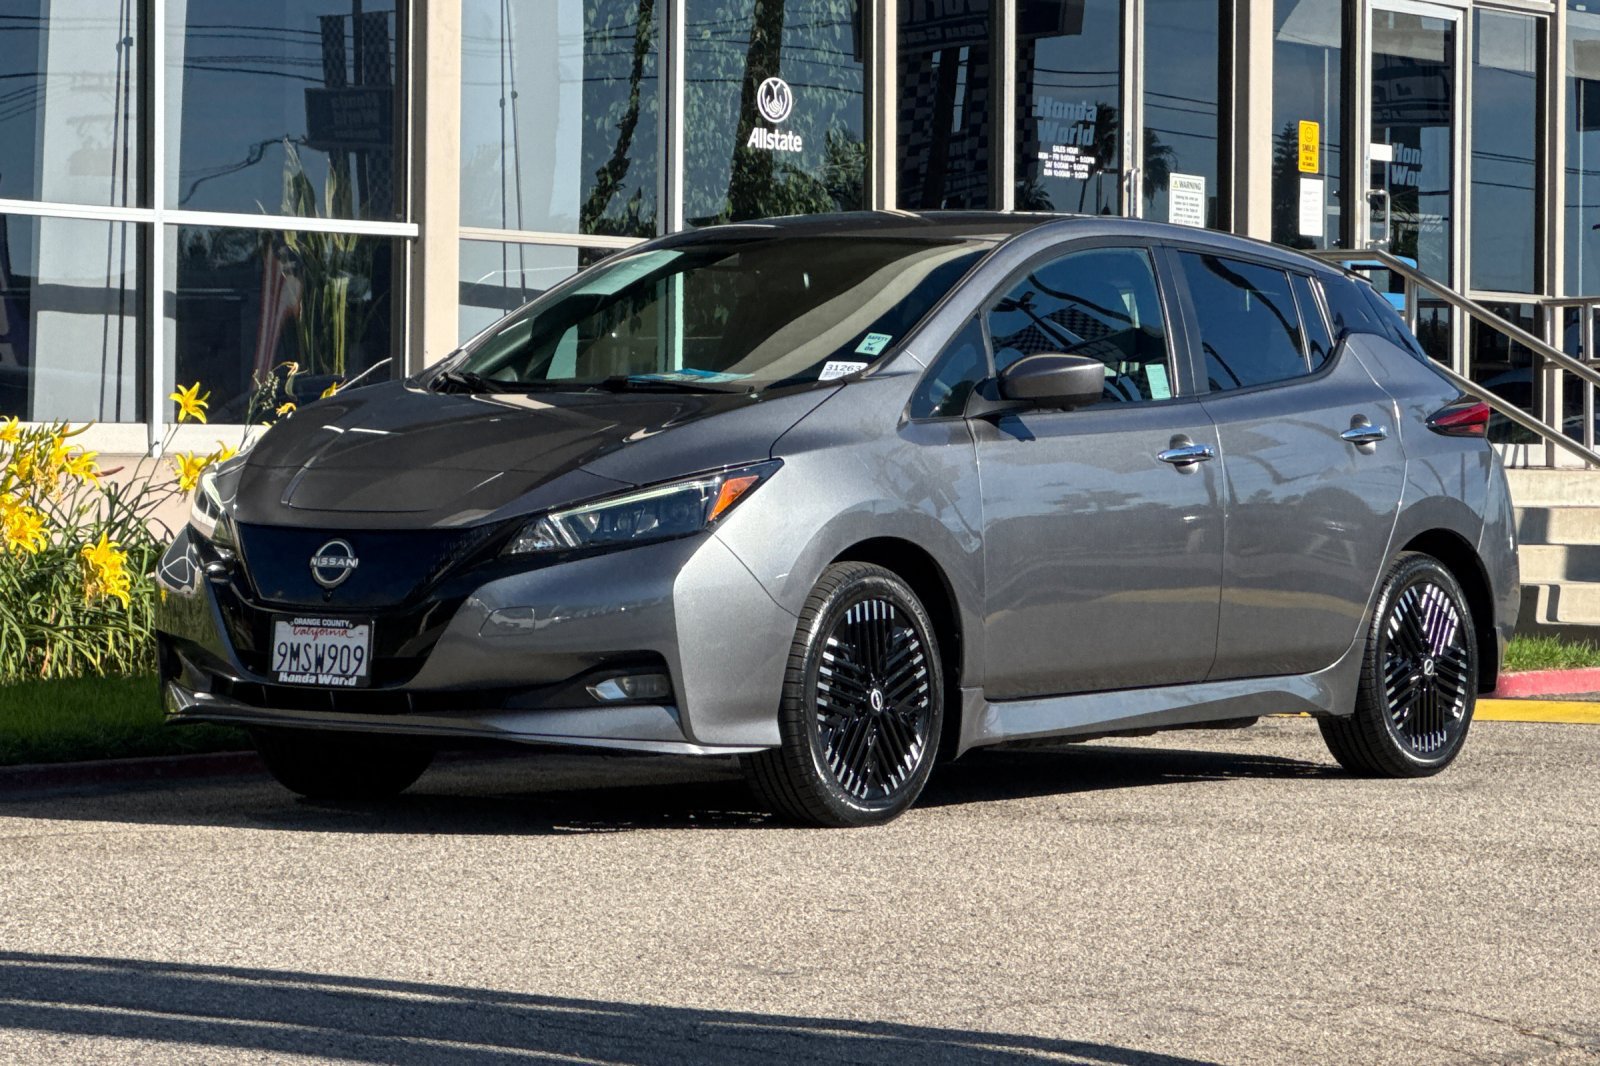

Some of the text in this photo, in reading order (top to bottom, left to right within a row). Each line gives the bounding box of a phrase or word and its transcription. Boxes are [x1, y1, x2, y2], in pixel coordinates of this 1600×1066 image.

[1038, 97, 1097, 121] Honda
[747, 127, 803, 152] Allstate
[1038, 120, 1095, 145] World
[1179, 180, 1201, 191] WARNING
[310, 557, 359, 568] NISSAN
[294, 617, 350, 628] ORANGE COUNTY
[293, 627, 354, 641] California
[277, 641, 365, 674] 9MSW909
[278, 672, 357, 686] Honda World
